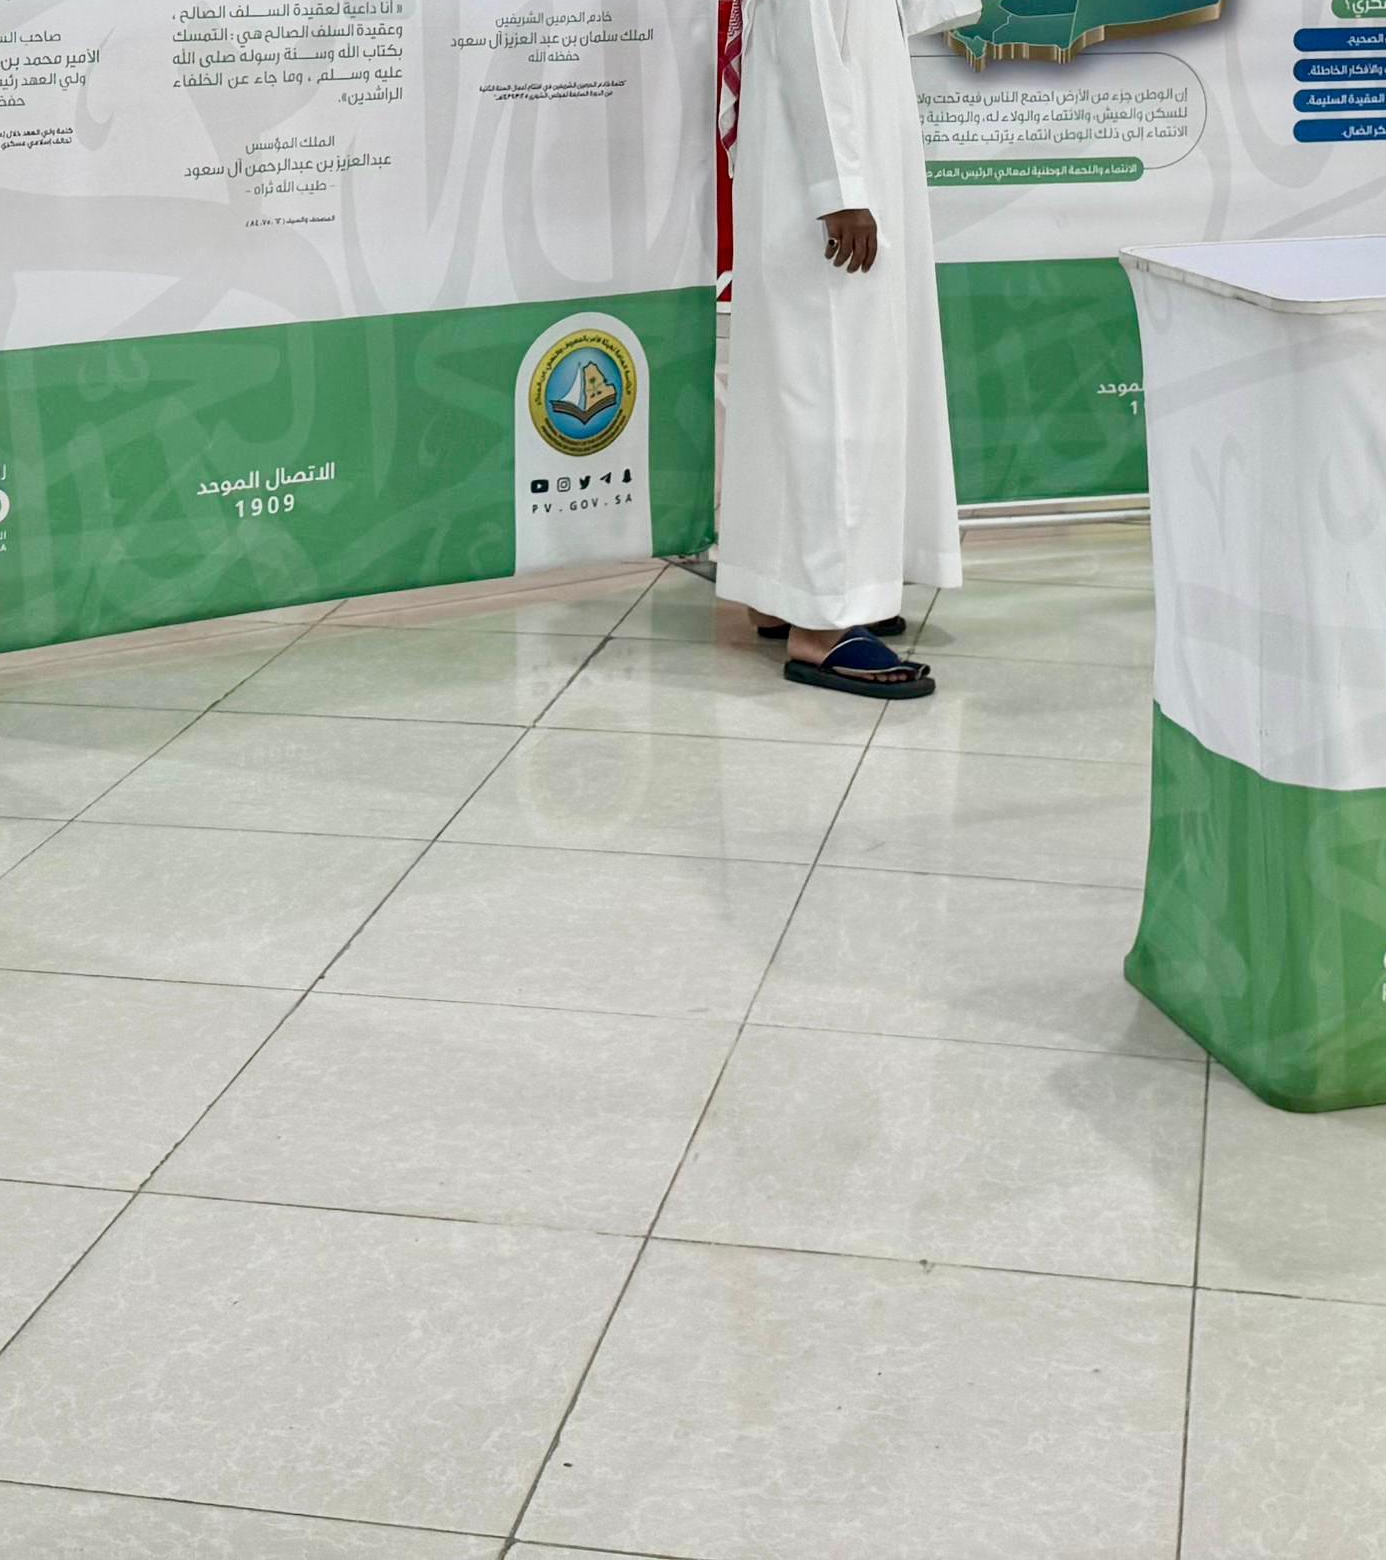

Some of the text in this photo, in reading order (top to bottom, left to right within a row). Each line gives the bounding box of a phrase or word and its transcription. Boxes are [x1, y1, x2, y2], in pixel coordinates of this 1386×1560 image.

[451, 29, 653, 50] الملك سلمان بن عبد العزيز آل سعود
[1, 57, 19, 71] بن
[23, 55, 61, 66] محمد
[66, 49, 99, 68] الأمير
[933, 88, 1187, 106] إن الوطن جزء من الأرض اجتمع الناس فيه تحت
[184, 166, 224, 180] سعود
[228, 159, 242, 178] آل
[316, 160, 333, 172] بن
[1096, 382, 1146, 397] موحد
[196, 460, 336, 497] الاتصال الموحد
[234, 492, 295, 519] 1909
